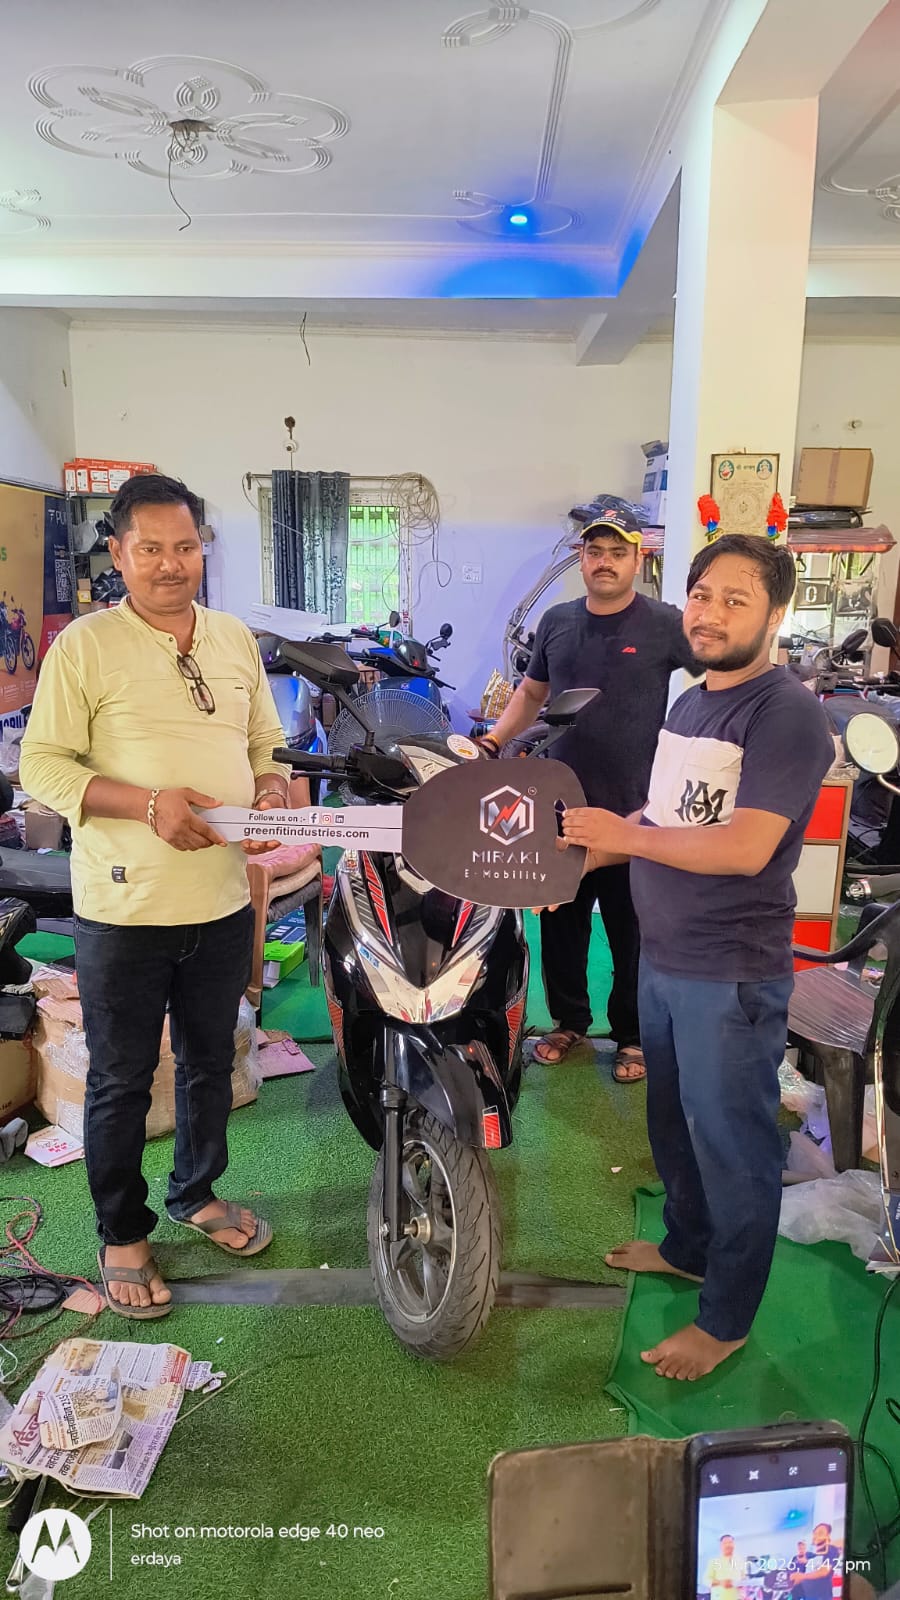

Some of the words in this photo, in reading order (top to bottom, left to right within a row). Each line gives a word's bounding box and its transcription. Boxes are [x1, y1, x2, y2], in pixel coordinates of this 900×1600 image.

[249, 813, 274, 822] Follow
[244, 826, 370, 839] greenfitindustries.com
[472, 850, 539, 865] MIRAKI
